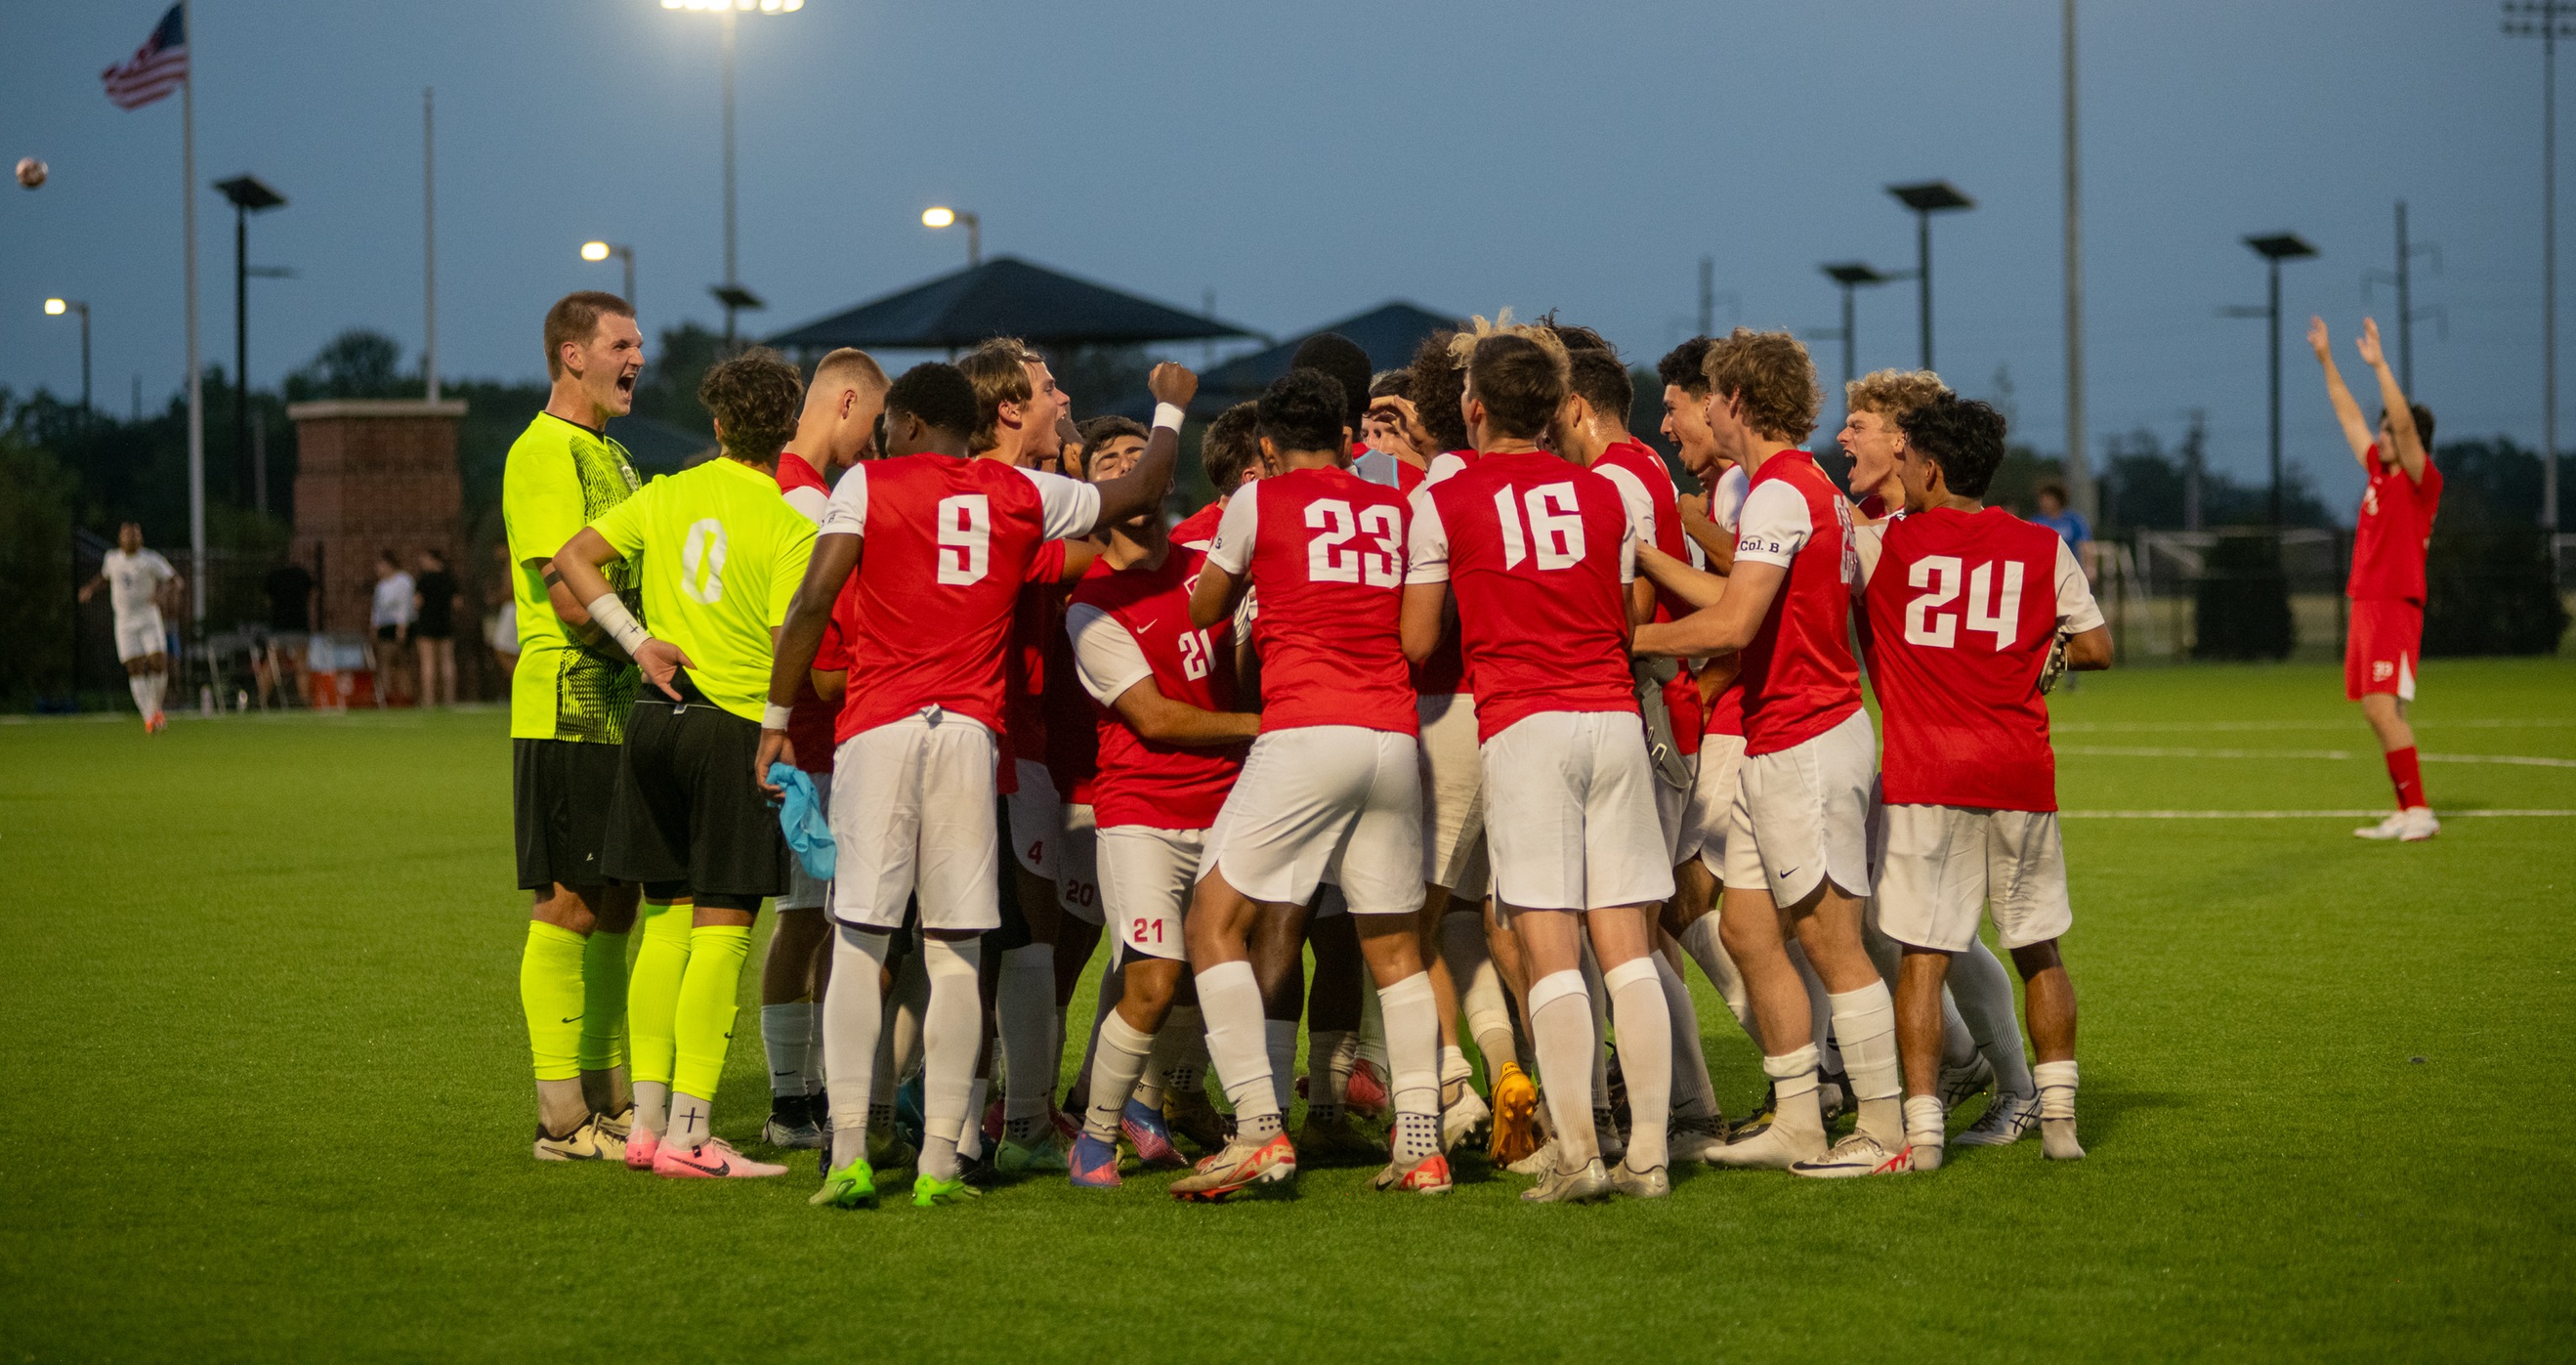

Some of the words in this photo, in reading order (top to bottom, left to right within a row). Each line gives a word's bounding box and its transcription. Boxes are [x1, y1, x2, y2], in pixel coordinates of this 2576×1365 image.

[681, 518, 728, 605] 0
[938, 493, 991, 586] 9
[1304, 497, 1403, 589] 23
[1494, 481, 1586, 572] 16
[1740, 539, 1764, 552] Col.
[1768, 542, 1780, 554] B
[1904, 554, 2025, 653] 24
[1178, 628, 1216, 682] 21
[1028, 841, 1043, 865] 4
[1066, 880, 1094, 907] 20
[1133, 918, 1163, 943] 21
